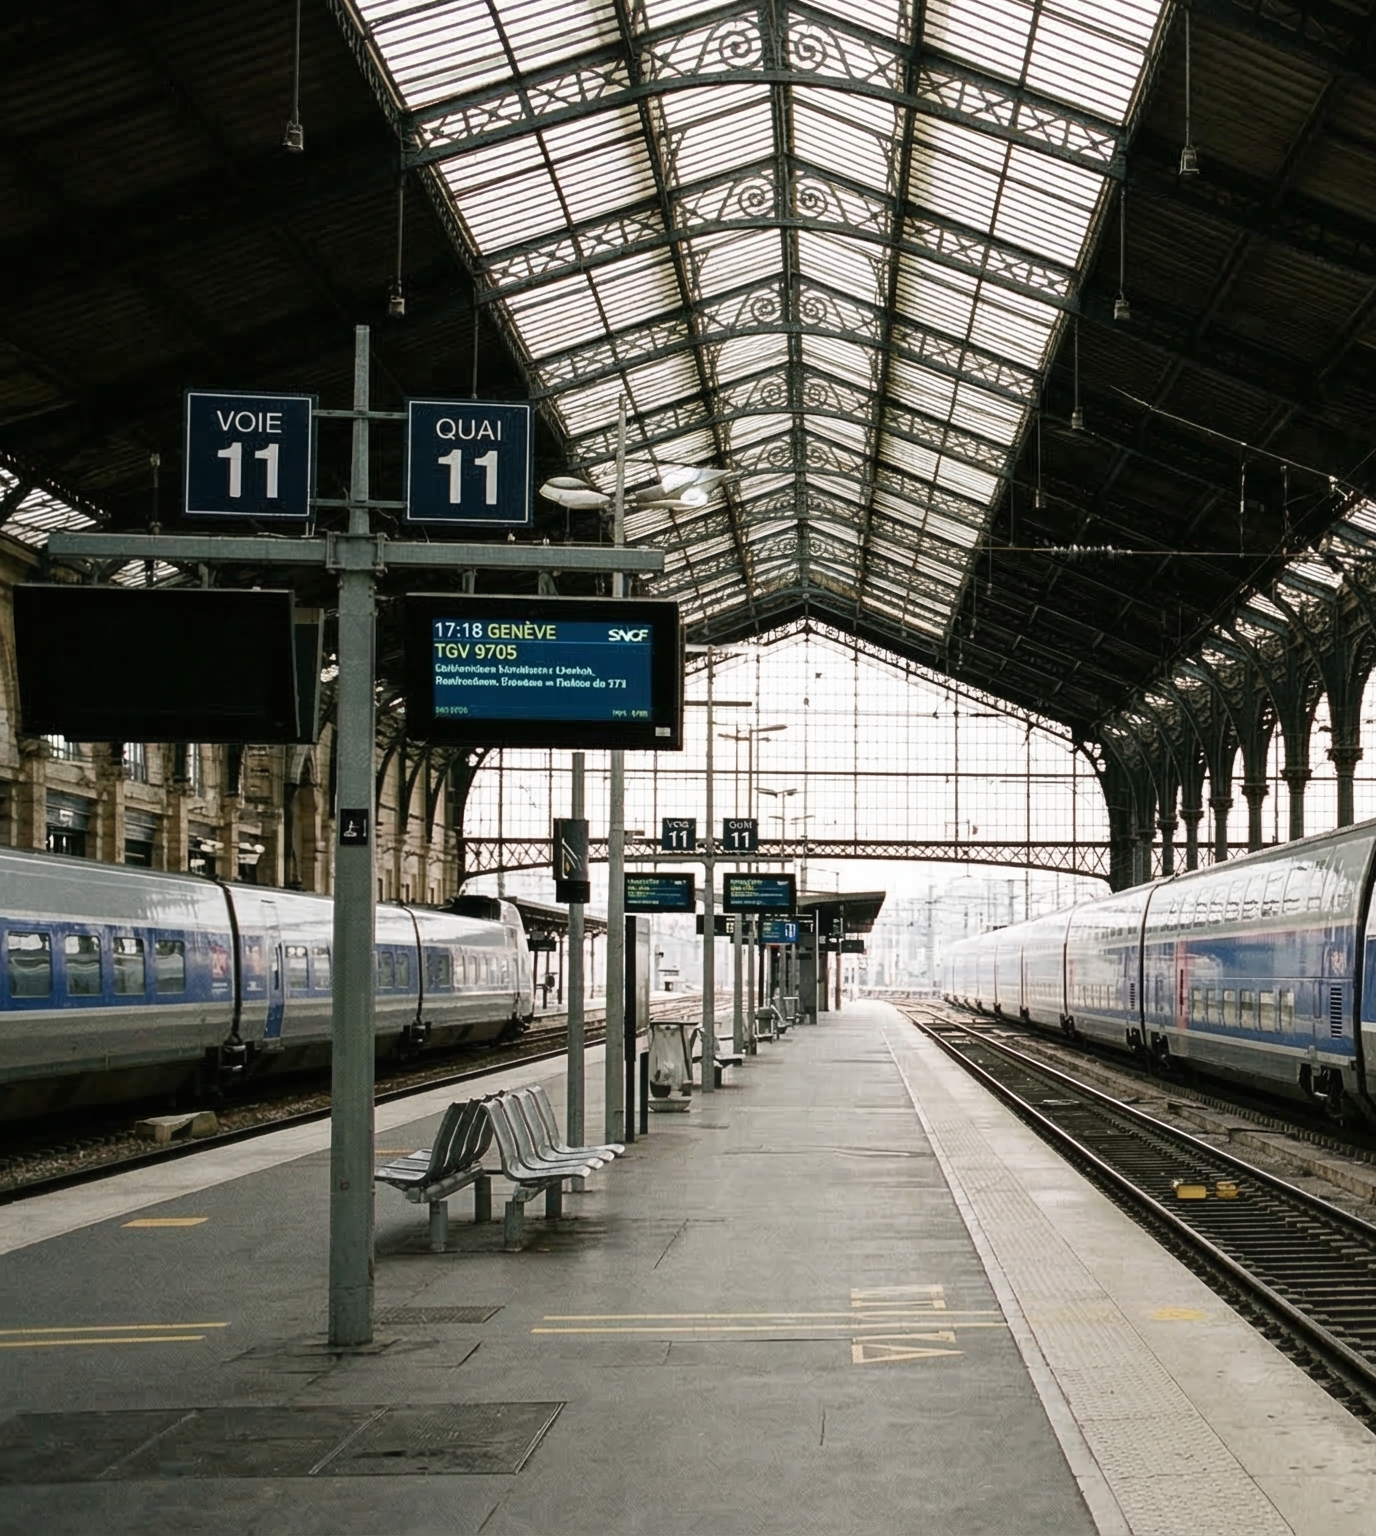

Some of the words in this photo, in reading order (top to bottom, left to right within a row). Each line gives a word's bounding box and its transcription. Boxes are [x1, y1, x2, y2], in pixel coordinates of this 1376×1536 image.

[216, 410, 283, 433] VOIE
[435, 418, 502, 441] QUAI
[217, 442, 279, 499] 11
[437, 448, 498, 505] 11
[434, 621, 483, 638] 17:18
[487, 620, 557, 640] GENÈVE
[607, 628, 649, 643] SNCF
[434, 643, 470, 659] TGV
[474, 643, 518, 660] 9705
[668, 830, 688, 848] 11
[731, 831, 751, 848] 11
